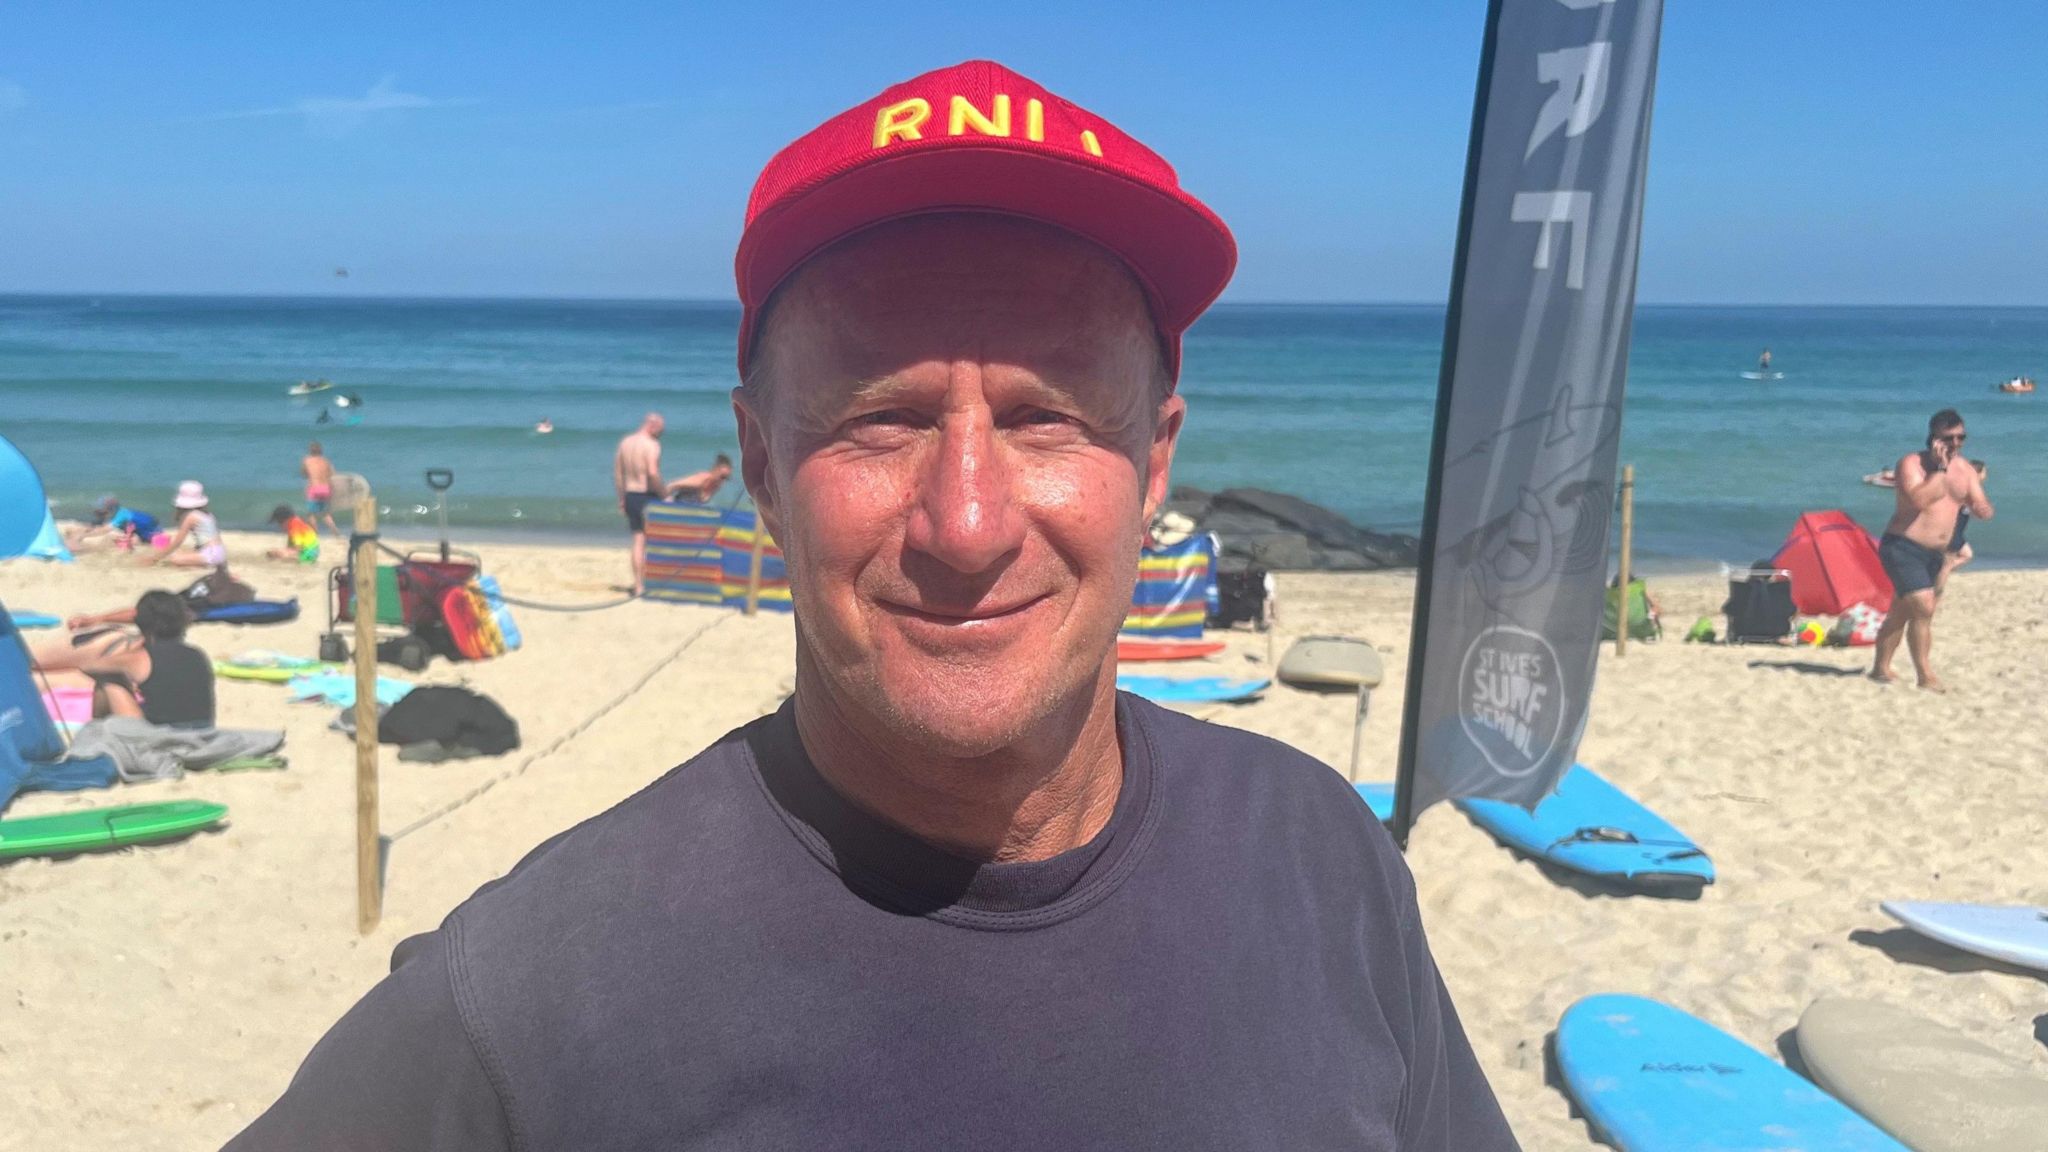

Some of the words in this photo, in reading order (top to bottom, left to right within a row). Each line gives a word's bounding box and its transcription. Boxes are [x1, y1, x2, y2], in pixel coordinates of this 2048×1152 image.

[1510, 0, 1616, 290] RF
[1479, 649, 1496, 668] ST
[1500, 651, 1542, 677] IVES
[1472, 669, 1547, 724] SURF
[1472, 702, 1533, 761] SCHOOL
